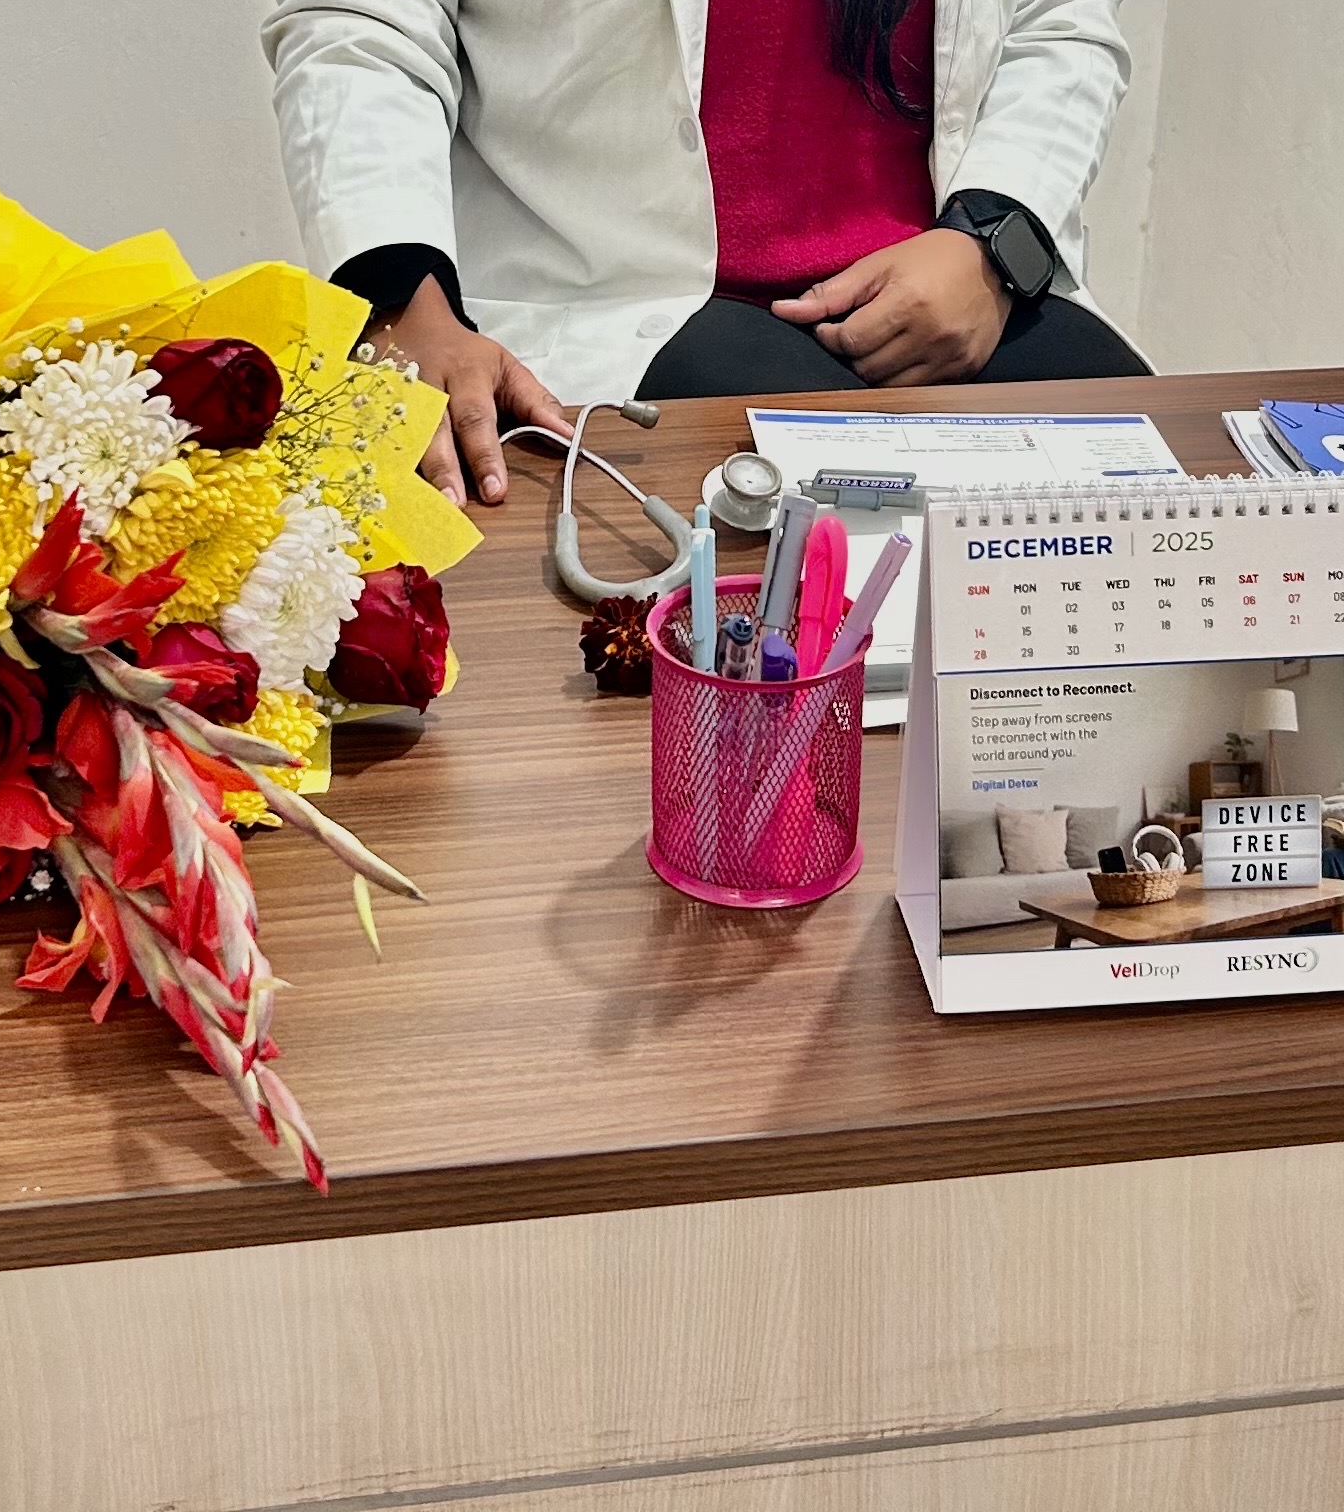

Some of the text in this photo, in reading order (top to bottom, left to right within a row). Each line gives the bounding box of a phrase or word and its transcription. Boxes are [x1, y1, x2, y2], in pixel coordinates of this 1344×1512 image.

[821, 477, 907, 489] MICROTONE
[967, 530, 1214, 561] DECEMBER 2025
[967, 584, 991, 597] SUN
[1013, 582, 1038, 595] MON
[1059, 580, 1083, 592] TUE
[1105, 578, 1131, 590] WED
[1153, 576, 1176, 588] THU
[1198, 575, 1216, 587] FRI
[1238, 573, 1260, 585] SAT
[1282, 571, 1306, 583] SUN
[1020, 604, 1032, 616] 01
[1064, 602, 1079, 614] 02
[1111, 600, 1126, 612] 03
[1157, 598, 1172, 610] 04
[1200, 596, 1215, 608] 05
[1242, 595, 1257, 606] 06
[1287, 593, 1301, 605] 07
[974, 628, 986, 639] 14
[1021, 625, 1033, 637] 15
[1067, 623, 1079, 635] 16
[1113, 621, 1125, 633] 17
[1159, 619, 1172, 631] 18
[1202, 618, 1214, 629] 19
[1243, 616, 1258, 627] 20
[1289, 614, 1301, 625] 21
[973, 643, 1126, 661] 28 29 30 31
[970, 682, 1137, 700] Disconnect to Reconnect.
[971, 711, 1113, 729] Step away from screens
[971, 728, 1098, 745] to reconnect with the
[972, 750, 1005, 762] world
[1007, 748, 1049, 760] around
[972, 779, 1038, 792] Digital Detox
[1219, 804, 1306, 824] DEVICE
[1233, 834, 1289, 853] FREE
[1231, 863, 1288, 882] ZONE
[1110, 962, 1181, 980] VelDrop
[1226, 951, 1308, 973] RESYNC
